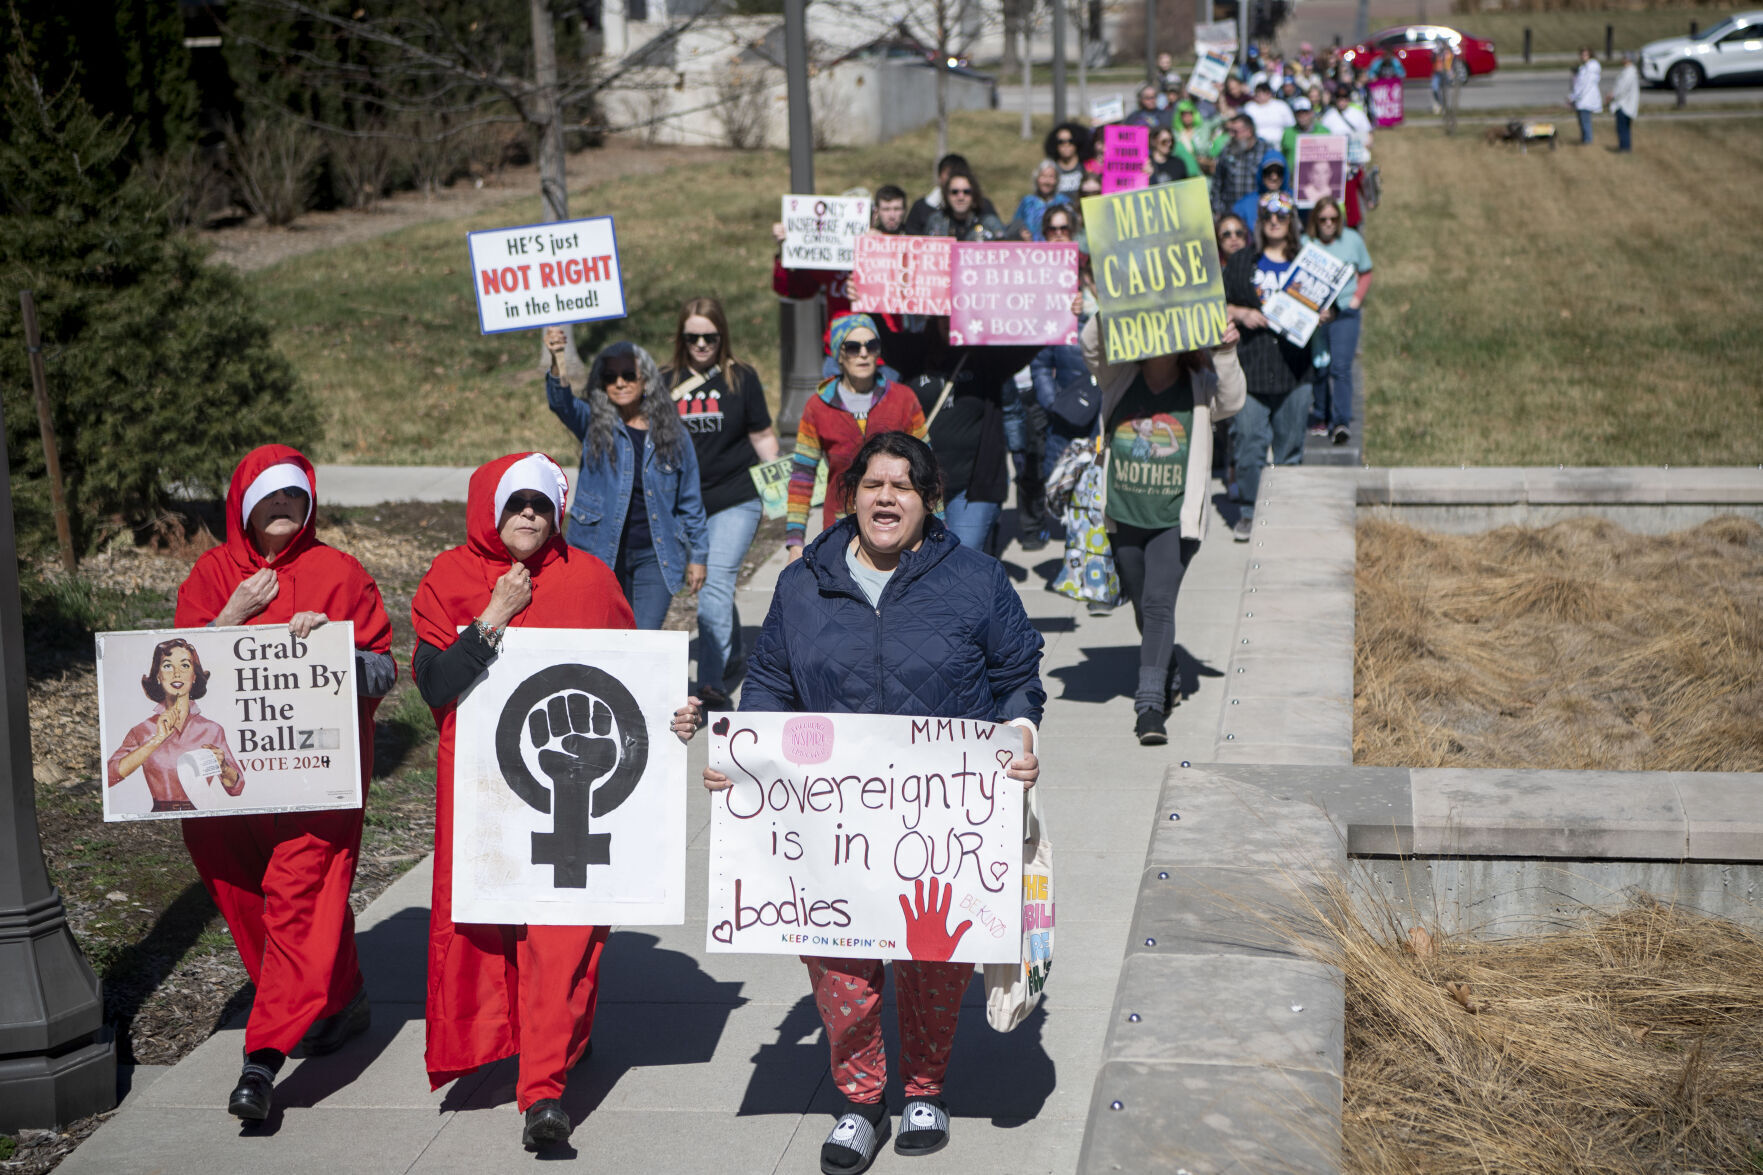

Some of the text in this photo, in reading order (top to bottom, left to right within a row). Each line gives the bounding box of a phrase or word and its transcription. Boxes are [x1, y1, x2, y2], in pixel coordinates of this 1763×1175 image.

[814, 200, 847, 218] ONLY
[1112, 188, 1180, 241] MEN
[507, 233, 579, 256] HE'S just
[958, 248, 1077, 266] KEEP YOUR
[481, 255, 612, 296] NOT RIGHT
[984, 268, 1053, 285] BIBLE
[1103, 240, 1208, 298] CAUSE
[504, 290, 600, 319] in the head!
[883, 295, 952, 316] VAGINA
[952, 292, 1078, 312] OUT OF MY
[991, 318, 1039, 336] BOX
[1108, 301, 1228, 361] ABORTION
[687, 416, 723, 434] SIST
[763, 458, 794, 482] PR
[1115, 459, 1182, 486] MOTHER
[233, 633, 308, 662] Grab
[234, 664, 348, 695] Him By
[235, 696, 294, 722] The
[911, 719, 996, 744] MMIW
[238, 756, 289, 772] VOTE
[726, 728, 998, 830] Sovereignty
[772, 821, 1004, 893] is in OUR
[735, 876, 852, 931] bodies
[781, 933, 896, 949] KEEP ON KEEPIN' ON
